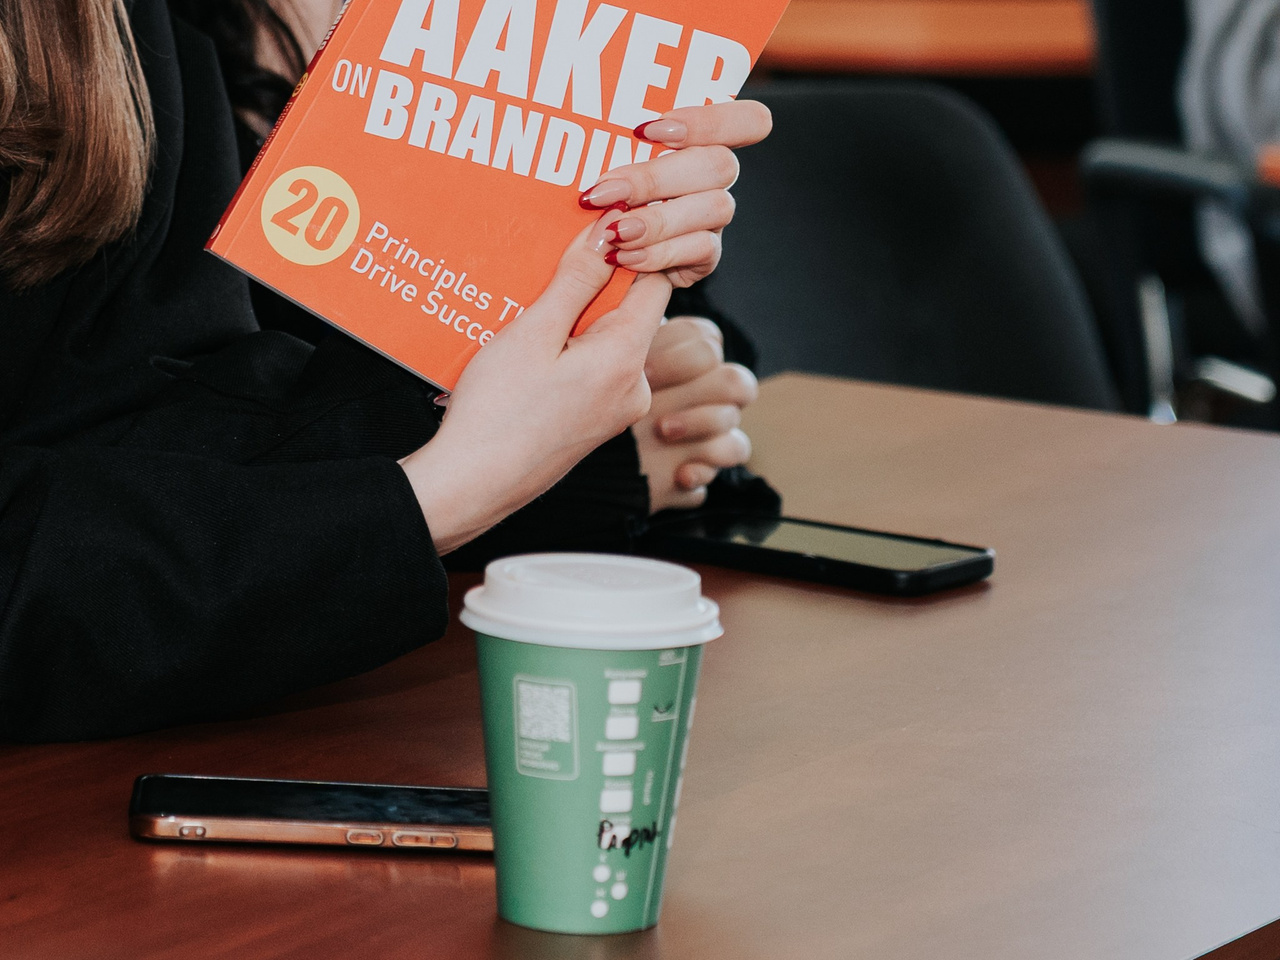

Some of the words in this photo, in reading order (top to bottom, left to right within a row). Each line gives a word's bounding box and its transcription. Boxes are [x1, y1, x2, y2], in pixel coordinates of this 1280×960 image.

[332, 58, 373, 100] ON
[270, 178, 350, 252] 20
[350, 247, 418, 302] Drive
[421, 290, 495, 347] Succe
[365, 221, 493, 310] Principles
